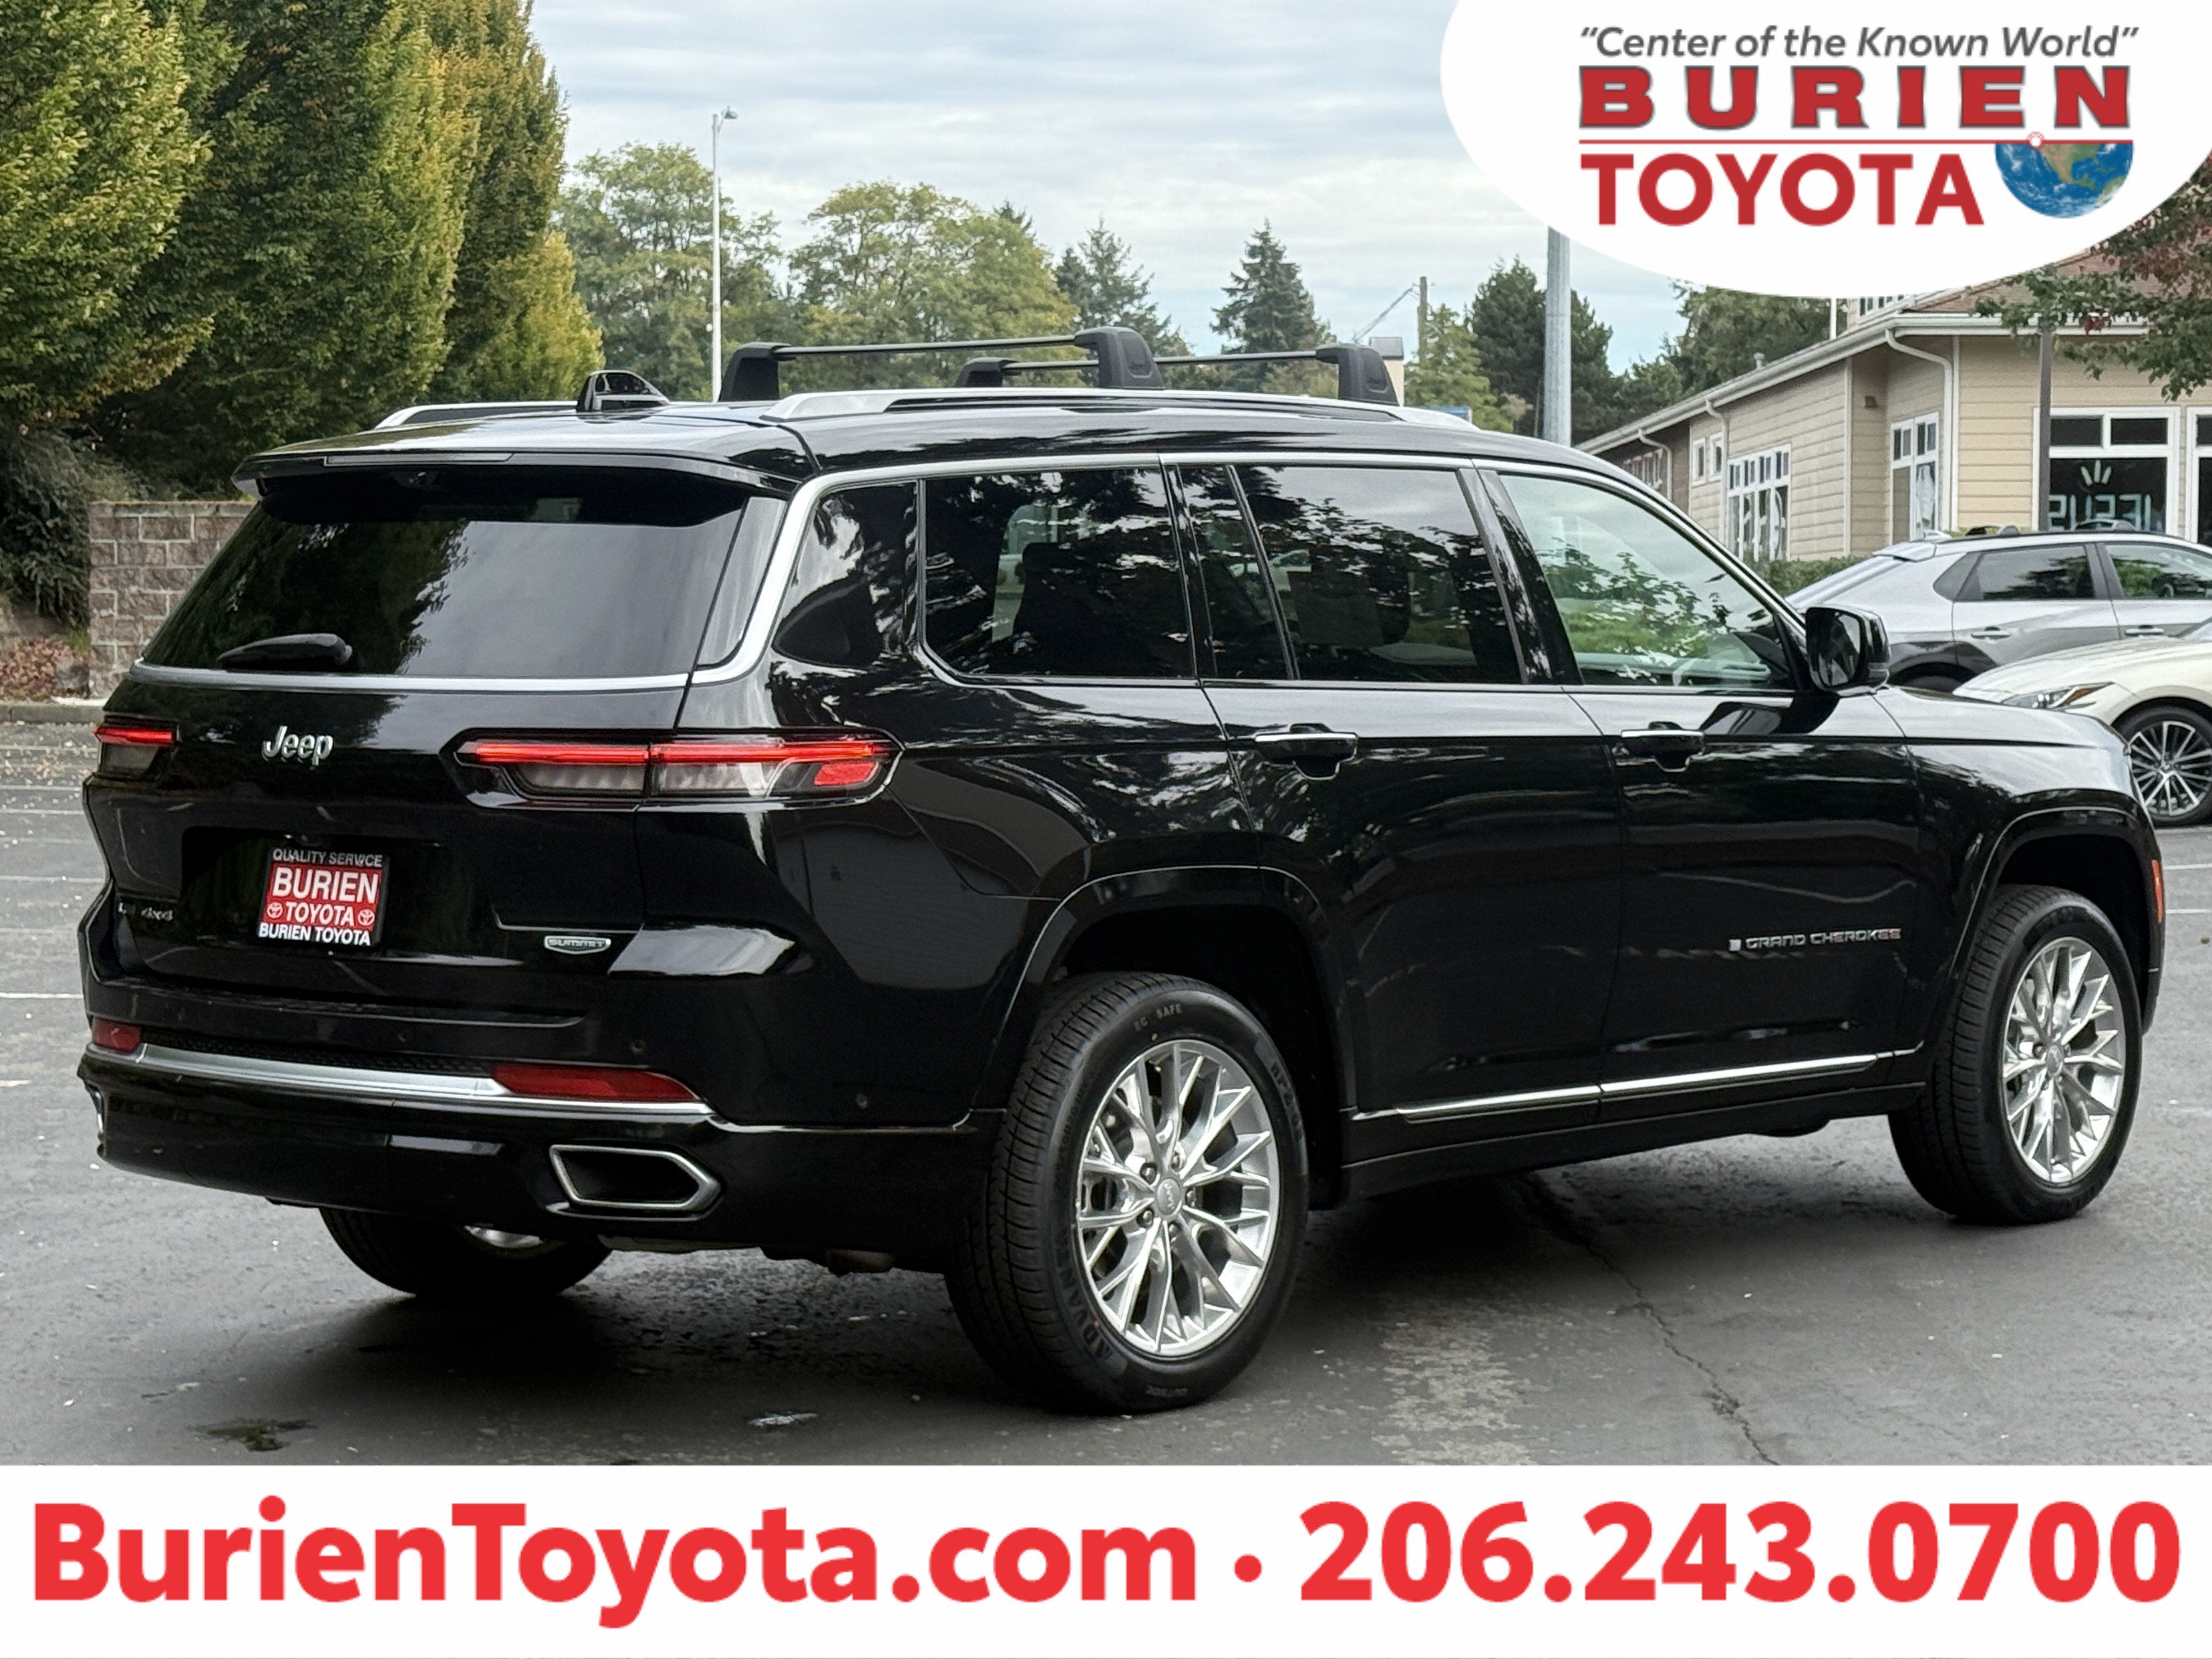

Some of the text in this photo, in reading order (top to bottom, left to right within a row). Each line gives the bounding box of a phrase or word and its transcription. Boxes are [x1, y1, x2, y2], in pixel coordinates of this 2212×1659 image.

[262, 725, 334, 766] Jeep
[273, 848, 383, 868] QUALITY SERVICE
[272, 866, 379, 904] BURIEN
[285, 901, 355, 927] TOYOTA
[258, 922, 371, 947] BURIEN TOYOTA
[1746, 928, 1901, 949] GRAND CHEROKEE
